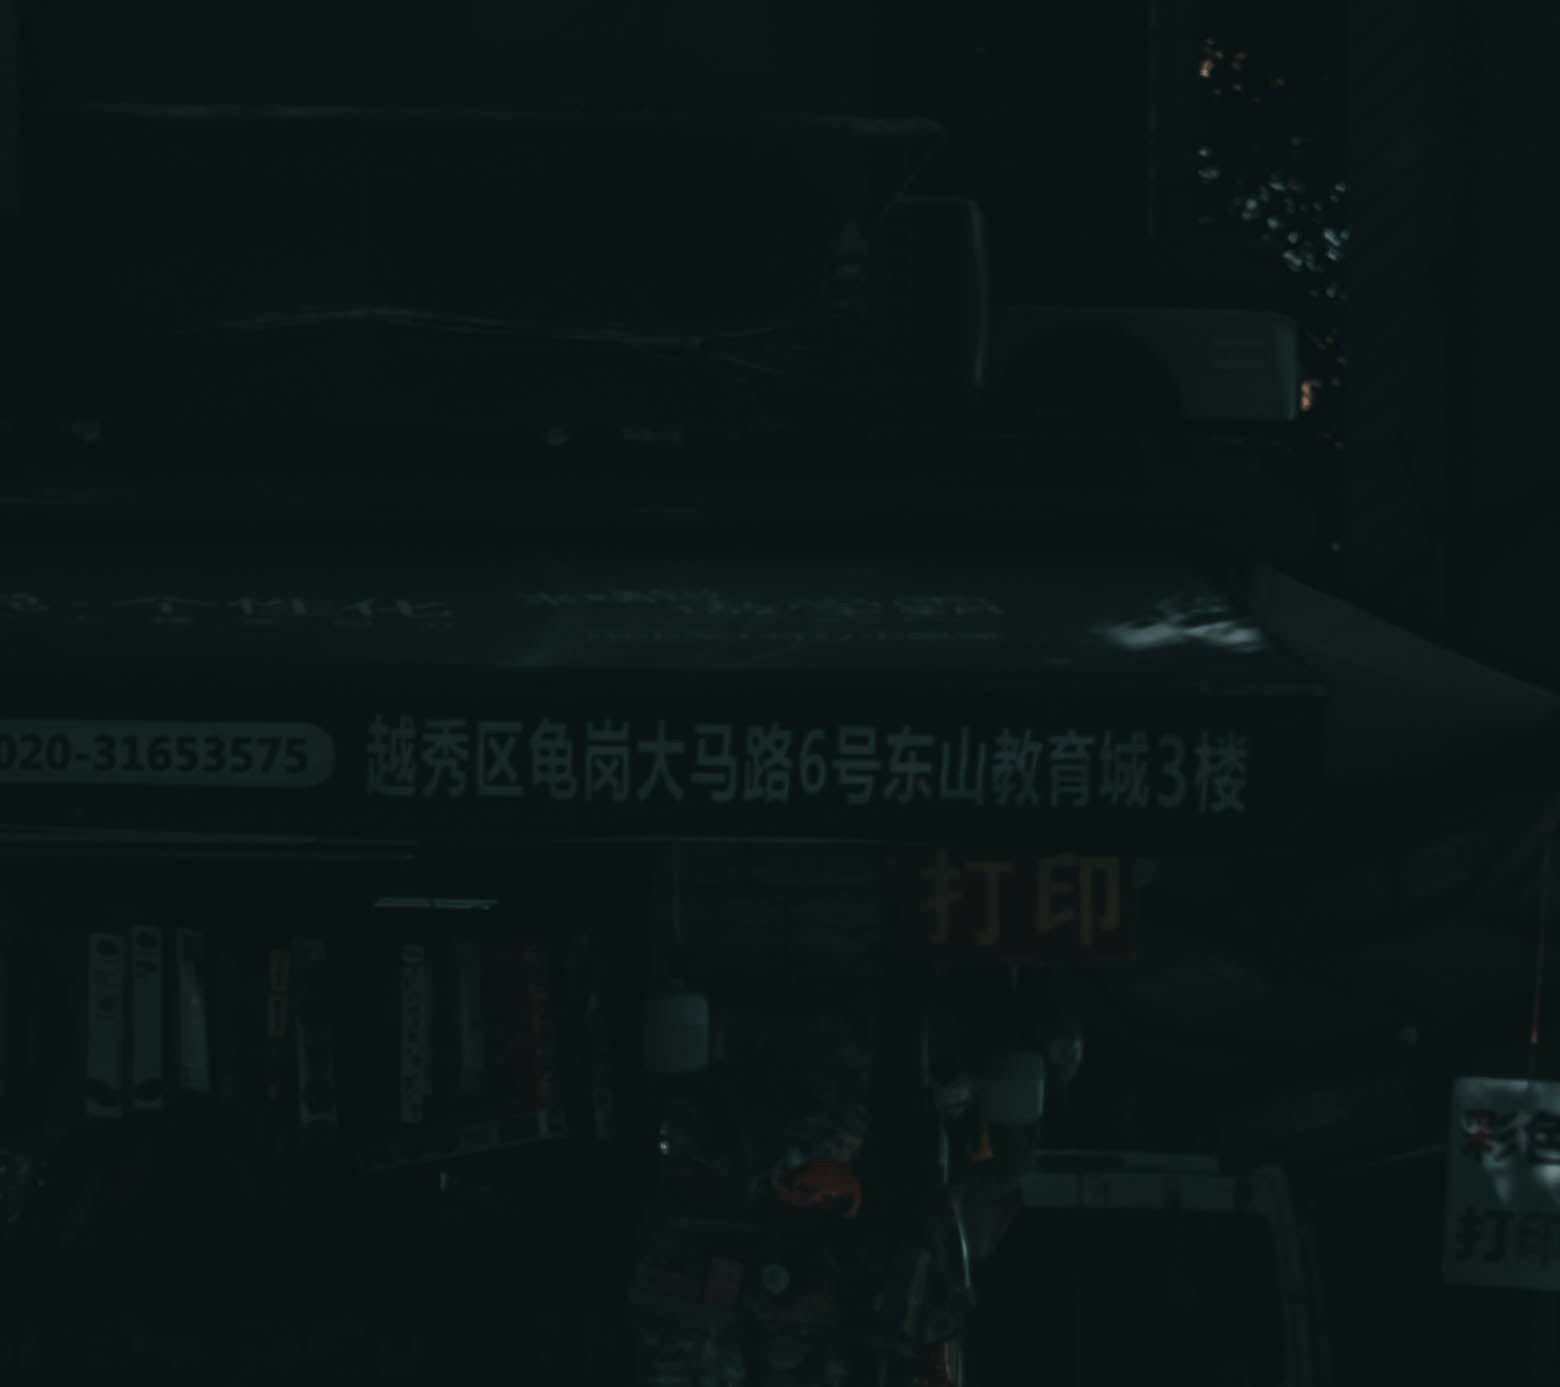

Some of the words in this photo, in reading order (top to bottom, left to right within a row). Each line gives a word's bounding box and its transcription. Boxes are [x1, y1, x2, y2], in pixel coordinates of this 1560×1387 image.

[364, 715, 1250, 815] 越秀区龟岗大马路6号东山教育城3楼
[920, 850, 1121, 948] 打印
